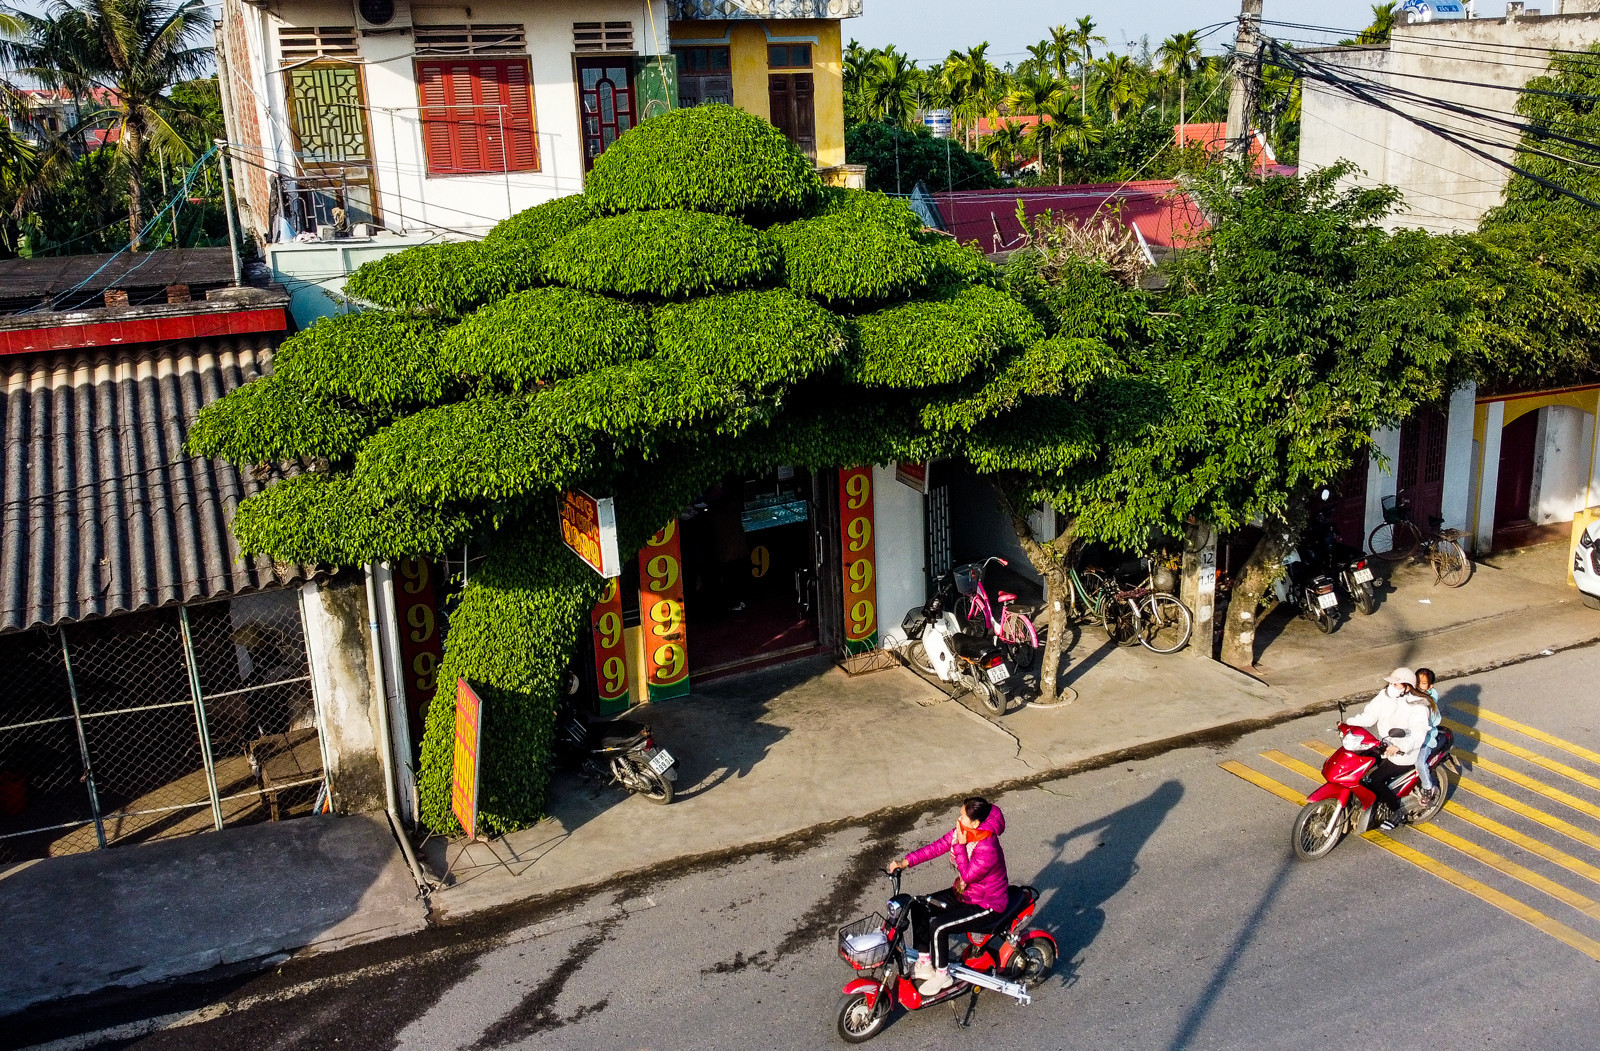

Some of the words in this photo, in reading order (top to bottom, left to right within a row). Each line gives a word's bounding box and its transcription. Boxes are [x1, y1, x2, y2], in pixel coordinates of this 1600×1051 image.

[562, 519, 600, 568] 9999
[1203, 553, 1214, 564] 12
[751, 545, 770, 578] 9
[459, 687, 476, 722] VÀNG
[453, 736, 475, 803] 9999
